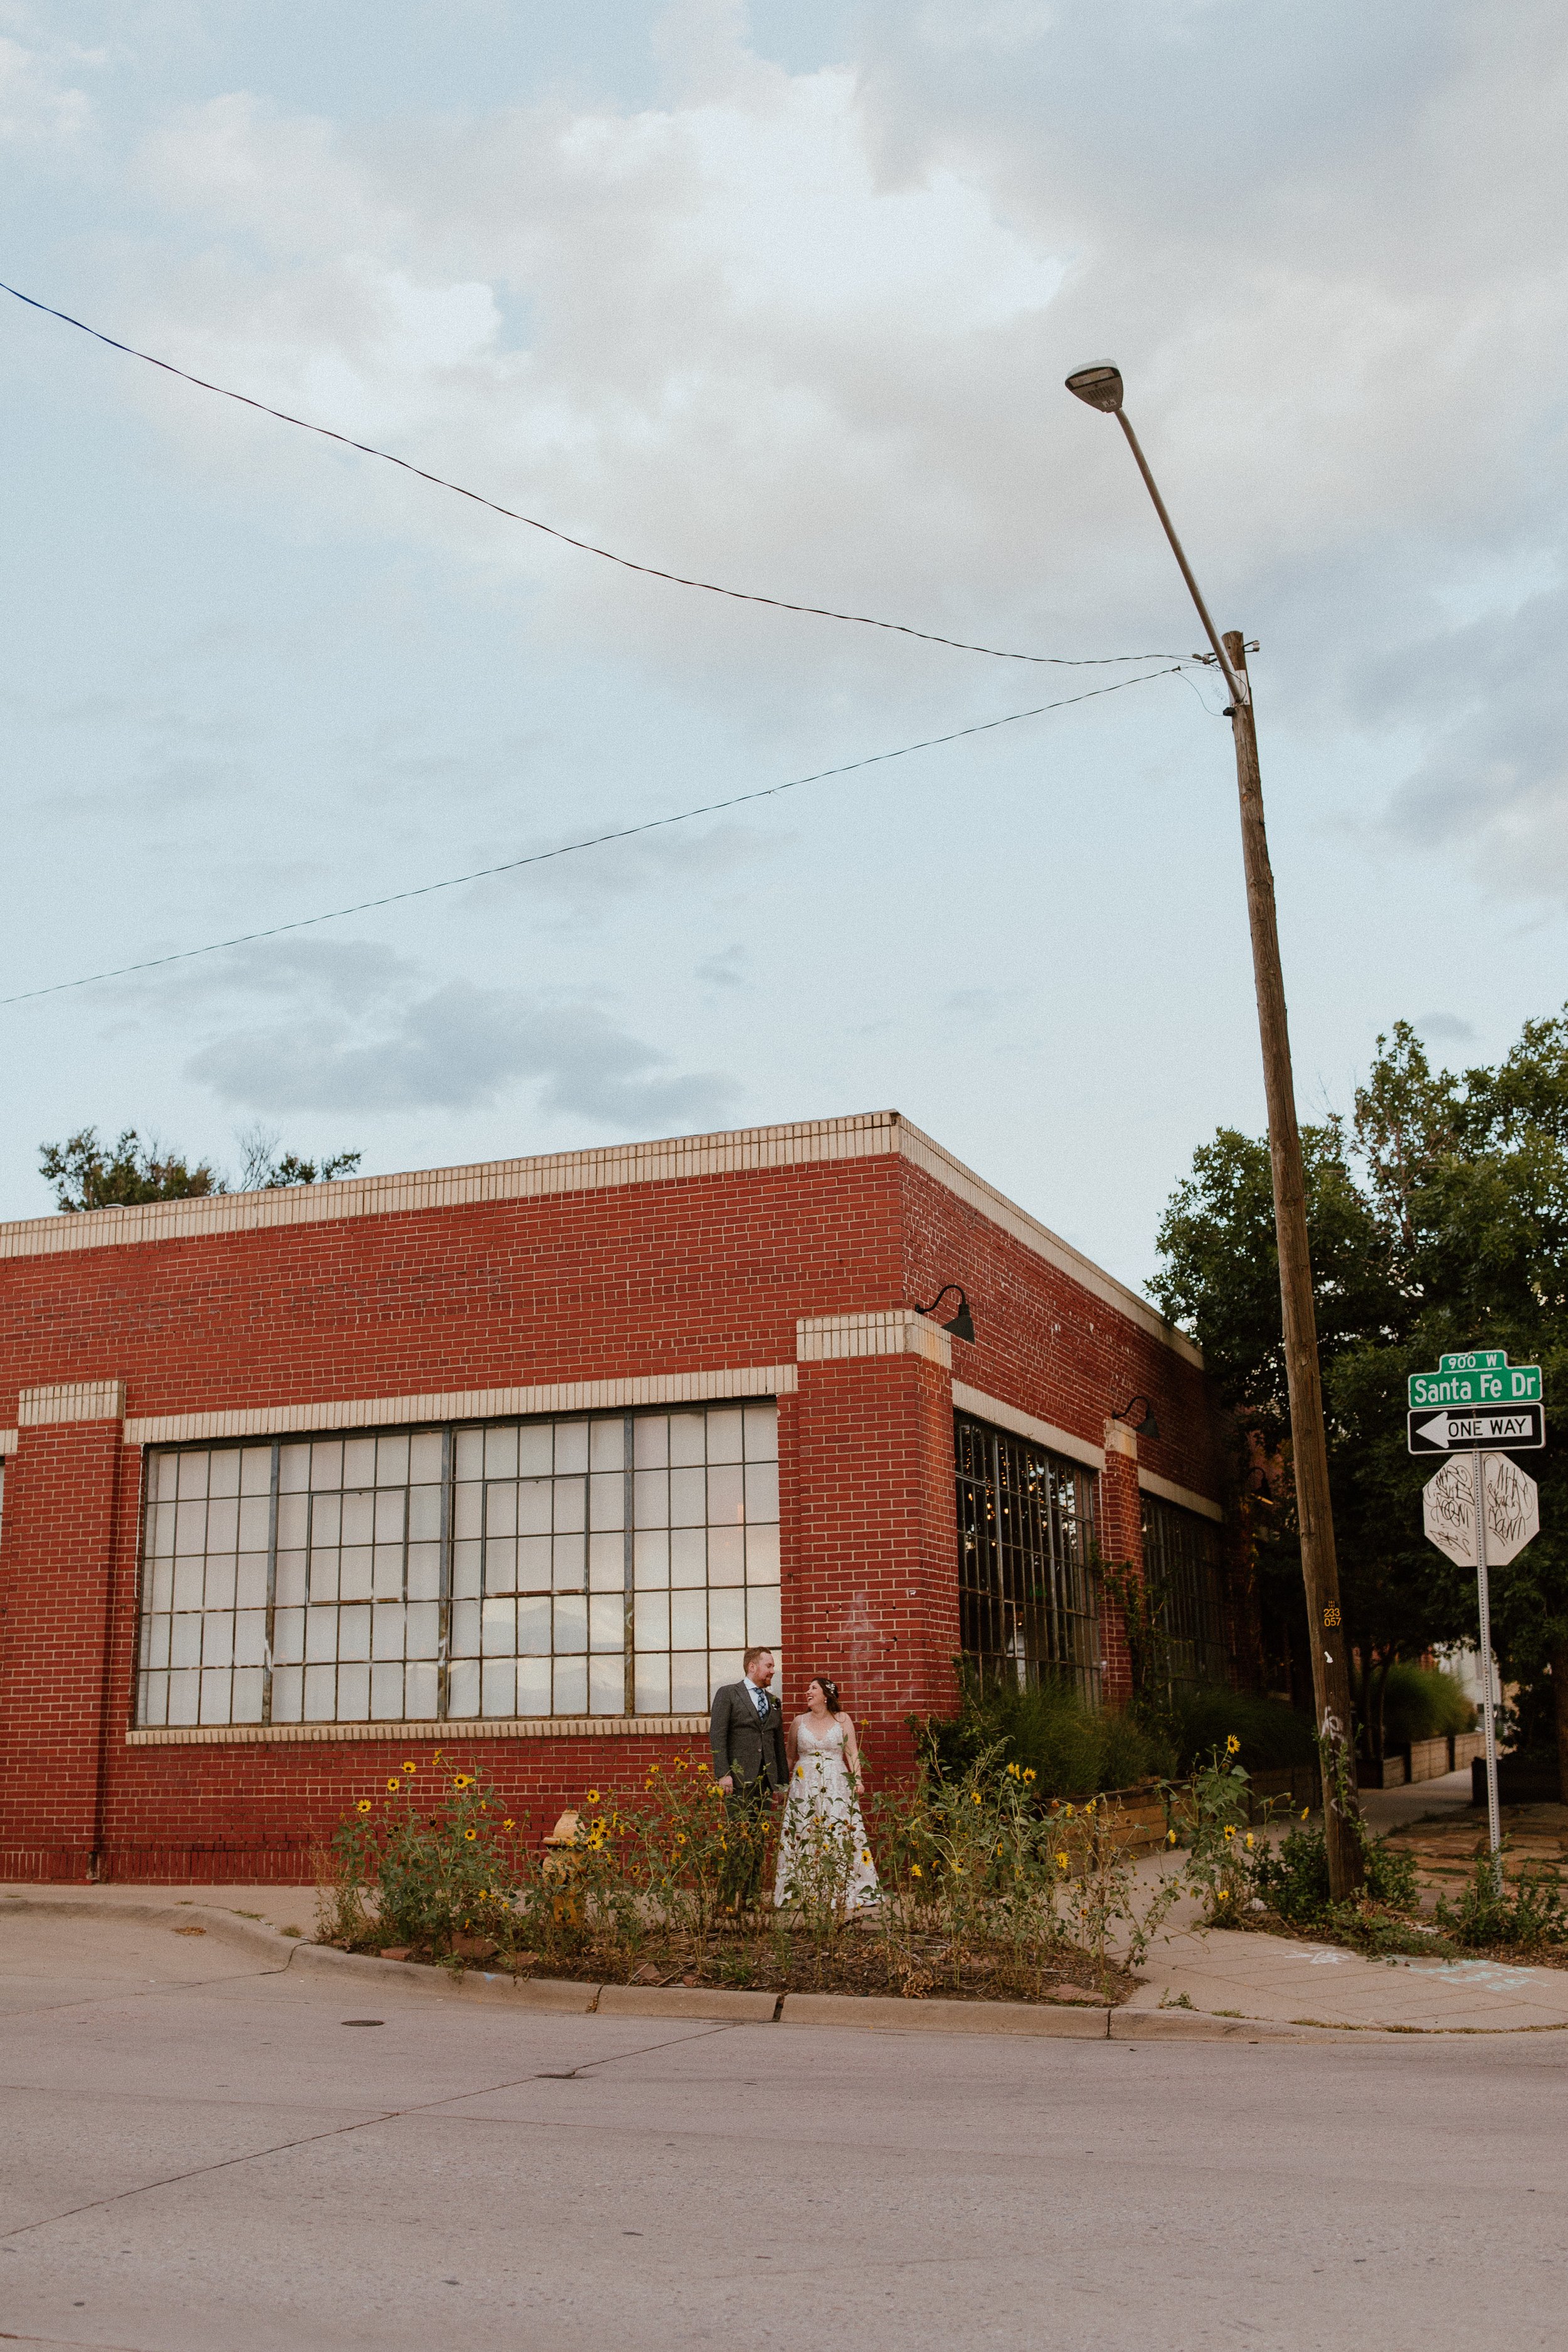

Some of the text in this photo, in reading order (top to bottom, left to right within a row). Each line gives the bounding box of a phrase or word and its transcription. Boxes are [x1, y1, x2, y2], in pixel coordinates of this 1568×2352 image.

[1448, 1354, 1497, 1369] 900 W
[1414, 1372, 1536, 1403] Santa Fe Dr
[1448, 1418, 1527, 1437] ONE WAY
[1323, 1608, 1340, 1618] 233
[1324, 1617, 1342, 1627] 057
